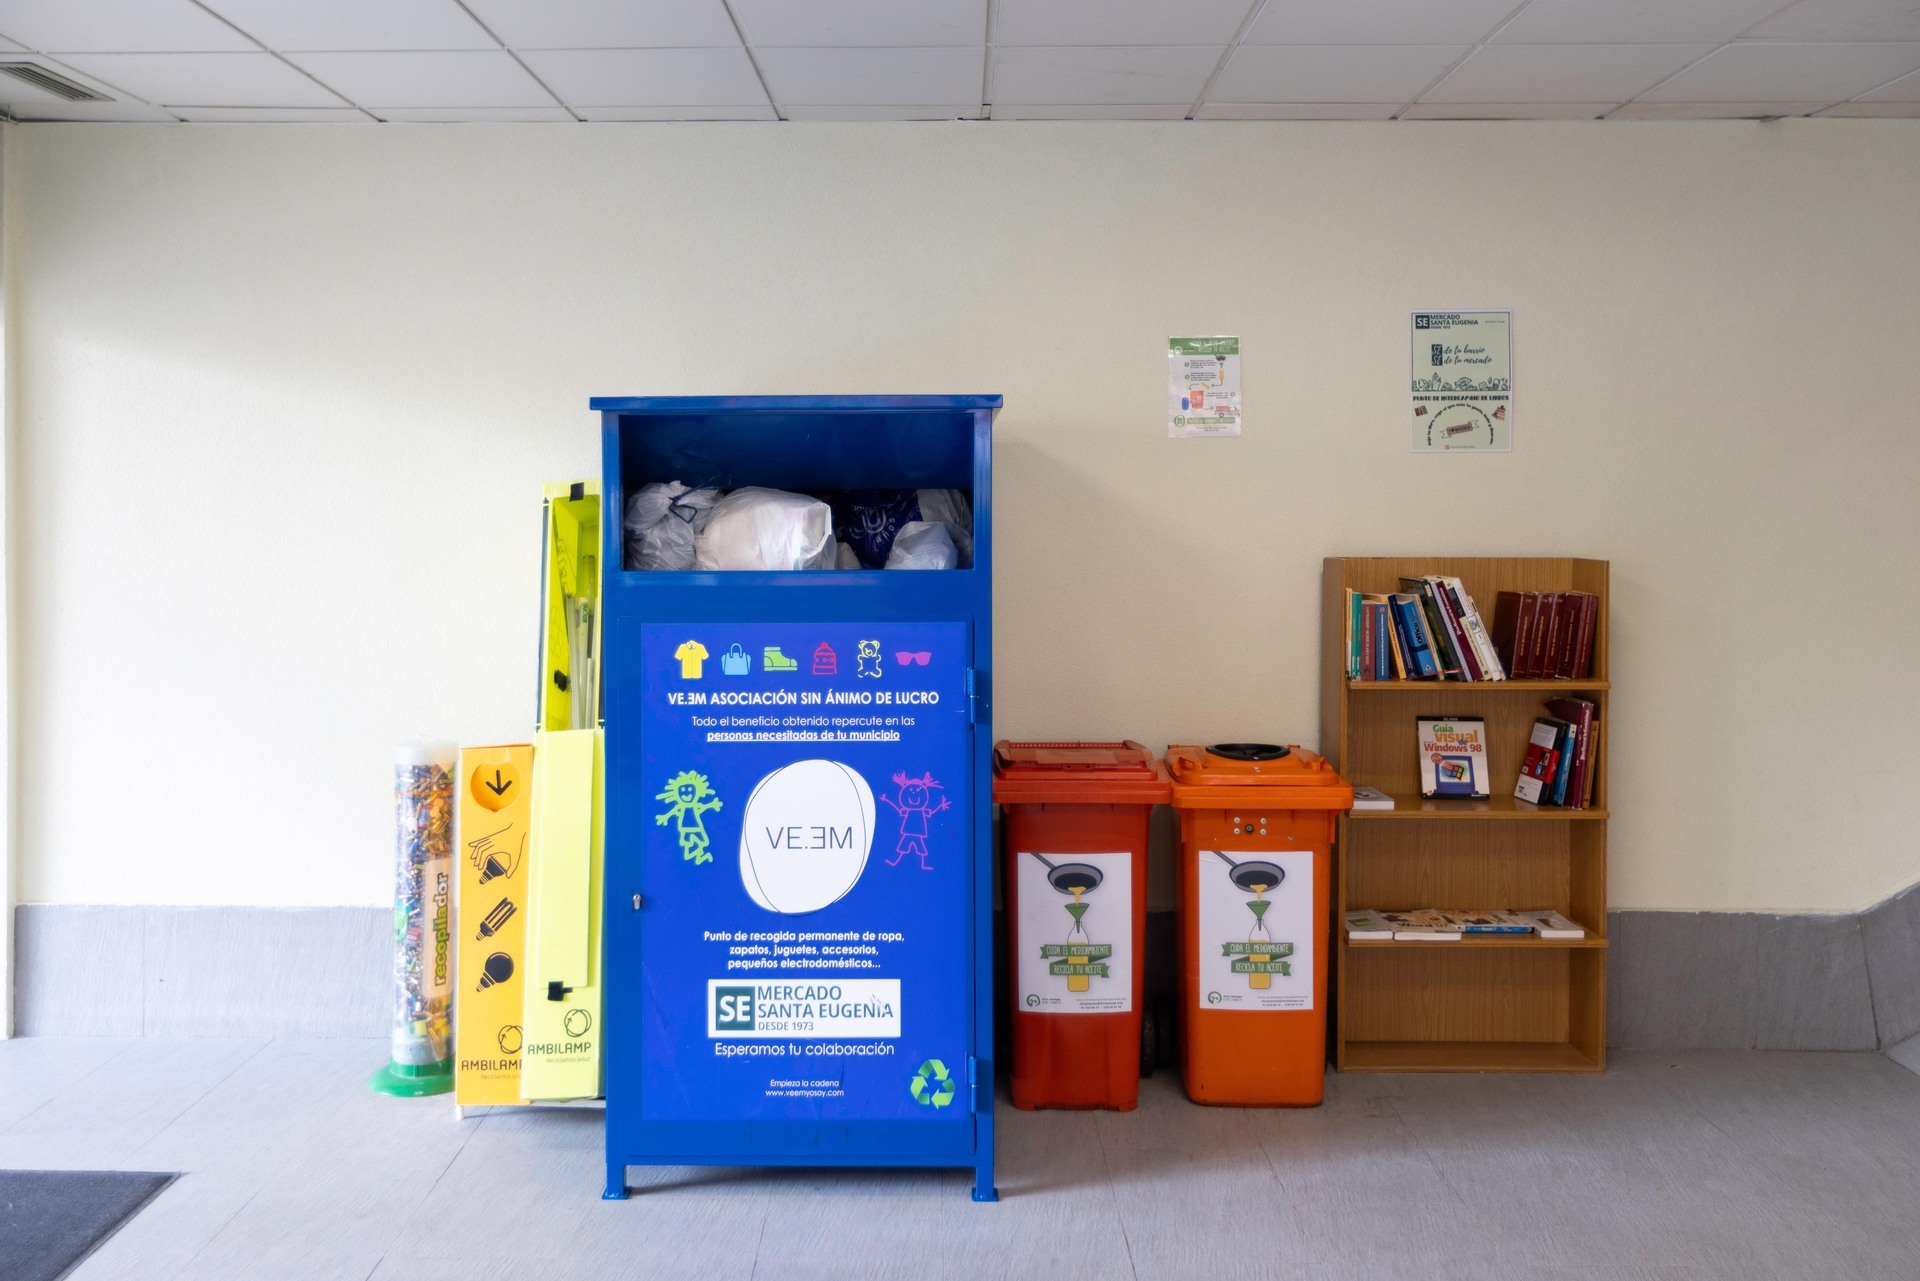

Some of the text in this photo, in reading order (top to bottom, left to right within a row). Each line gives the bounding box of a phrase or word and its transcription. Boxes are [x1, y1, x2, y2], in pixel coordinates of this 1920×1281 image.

[1416, 317, 1429, 327] SE
[1443, 346, 1452, 354] de
[1454, 345, 1462, 354] tu
[1464, 344, 1485, 354] barrio
[1443, 356, 1452, 364] de
[1454, 355, 1462, 364] tu
[1464, 355, 1492, 364] mercado
[1412, 622, 1423, 643] Office
[710, 689, 797, 705] ASOCIACIÓN
[801, 692, 821, 704] SIN
[826, 689, 872, 704] ÁNIMO
[876, 692, 891, 704] DE
[896, 692, 939, 704] LUCRO
[692, 716, 915, 728] Todo el beneficio obtenido repercute en las
[1433, 724, 1453, 732] Guía
[707, 730, 900, 741] personas necesitadas de tu municipio
[1434, 729, 1479, 743] visual
[1424, 743, 1482, 752] Windows 98
[434, 872, 449, 986] recopilador
[704, 931, 904, 944] Punto de recogida permanente de ropa,
[730, 945, 879, 957] zapatos, juguetes, accesorios,
[1047, 946, 1109, 955] CUIDA EL MEDIOAMBIENTE
[1231, 944, 1243, 952] CUIDA
[1246, 944, 1251, 952] EL
[728, 957, 881, 970] pequeños electrodomésticos...
[1236, 962, 1282, 971] RECICLA TU ACEITE
[1054, 965, 1102, 974] RECICLA TU ACEITE
[758, 985, 842, 1000] MERCADO
[719, 995, 751, 1023] SE
[758, 1003, 893, 1018] SANTA EUGENIA
[759, 1022, 814, 1031] DESDE 1973
[527, 1042, 591, 1055] AMBILAMP
[716, 1042, 894, 1057] Esperamos tu colaboración
[770, 1080, 800, 1089] Empieza
[766, 1088, 844, 1097] www.veemyosoy.com
